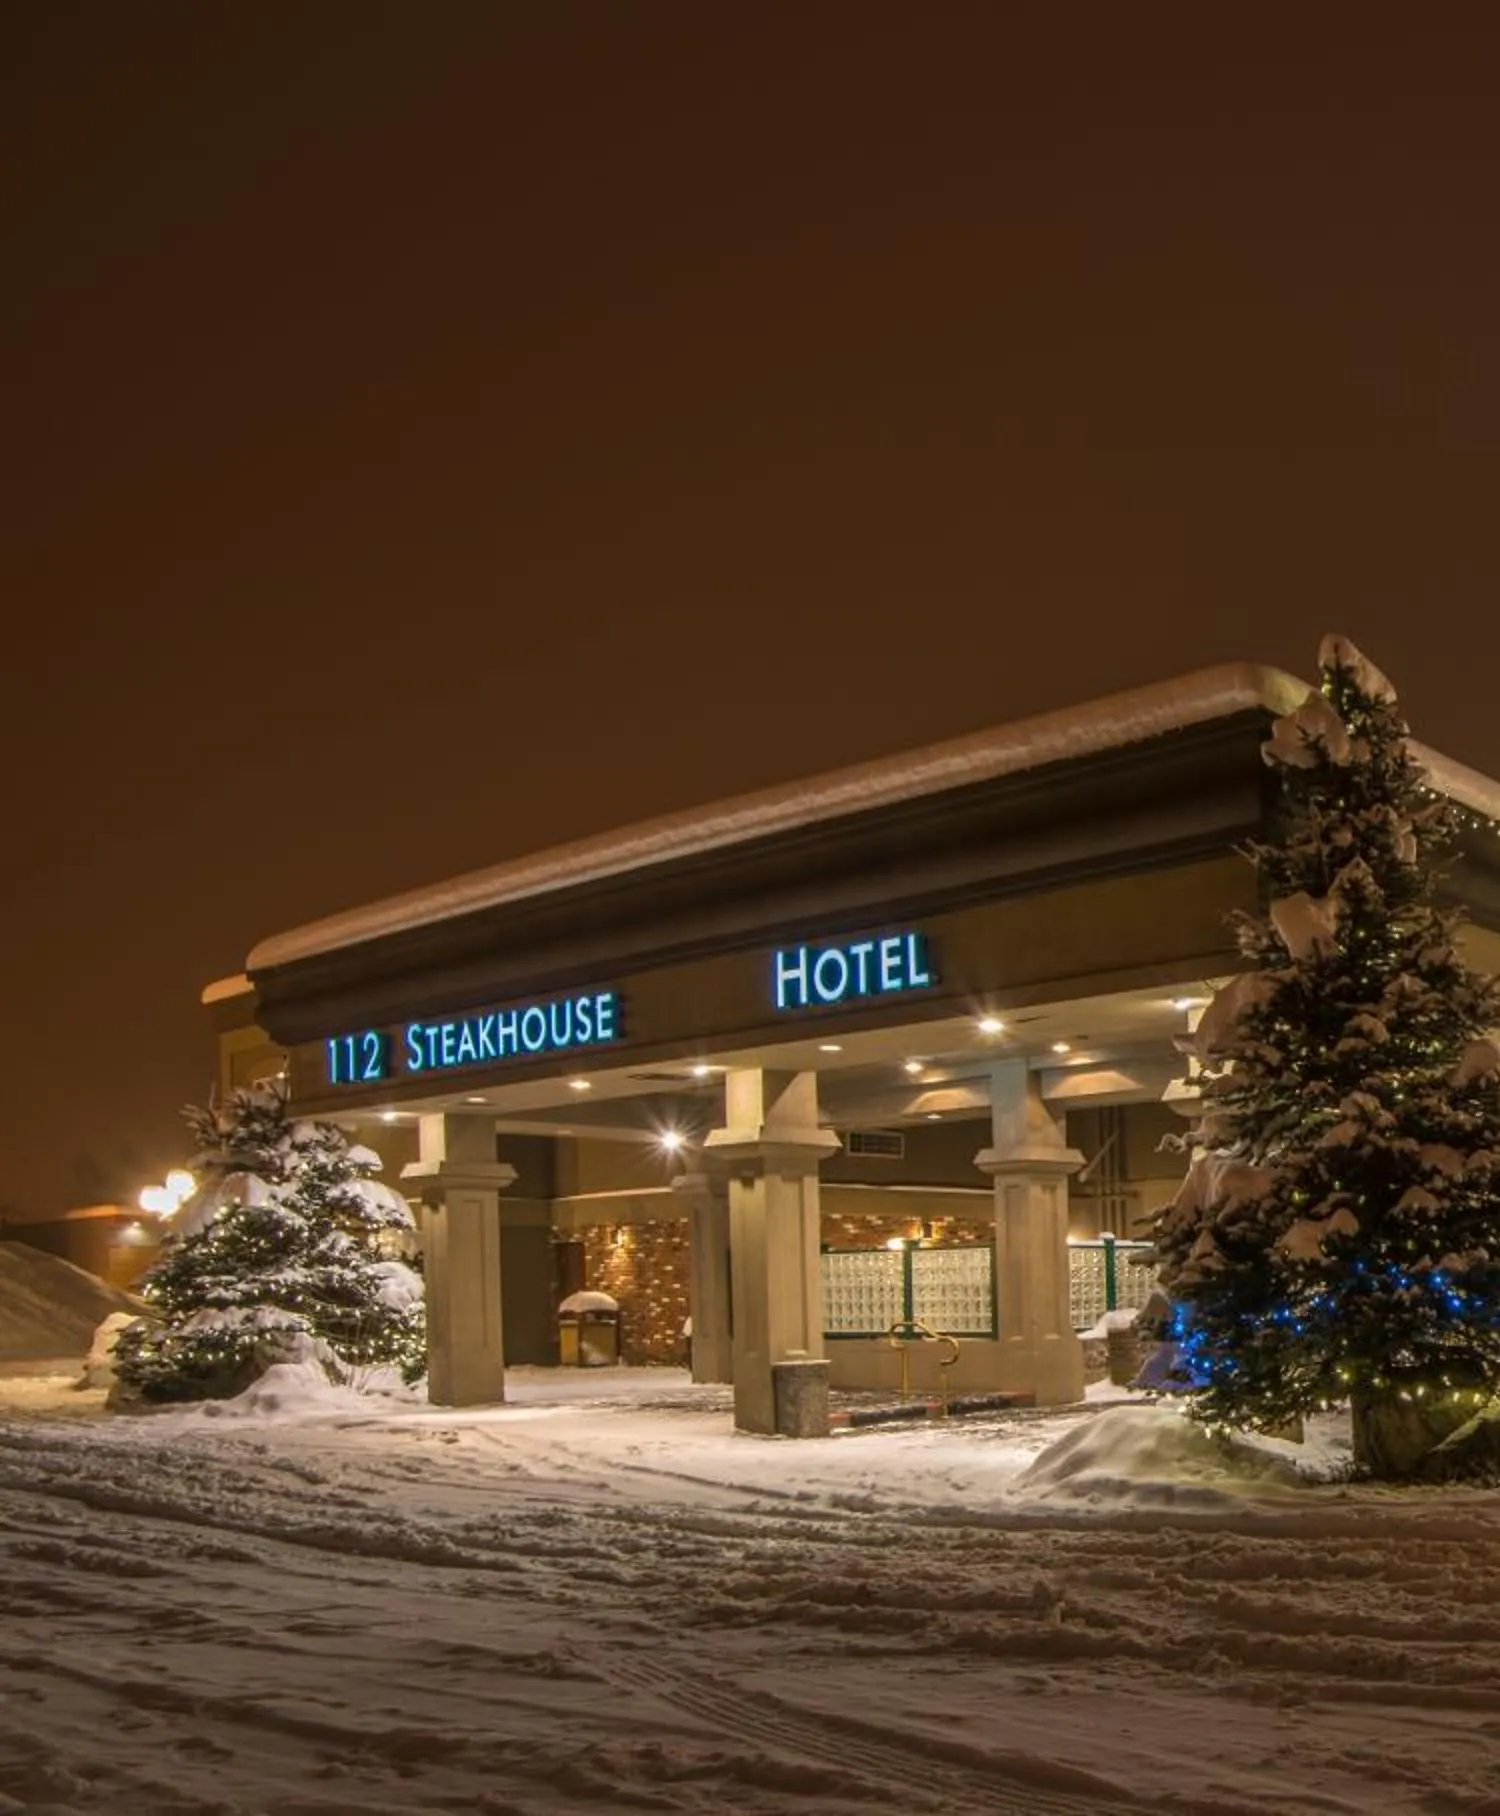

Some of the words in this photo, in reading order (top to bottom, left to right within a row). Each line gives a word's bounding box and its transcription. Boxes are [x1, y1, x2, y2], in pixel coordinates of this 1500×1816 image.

[776, 933, 930, 1008] HOTEL
[328, 1031, 383, 1084] 112
[406, 992, 615, 1071] STEAKHOUSE
